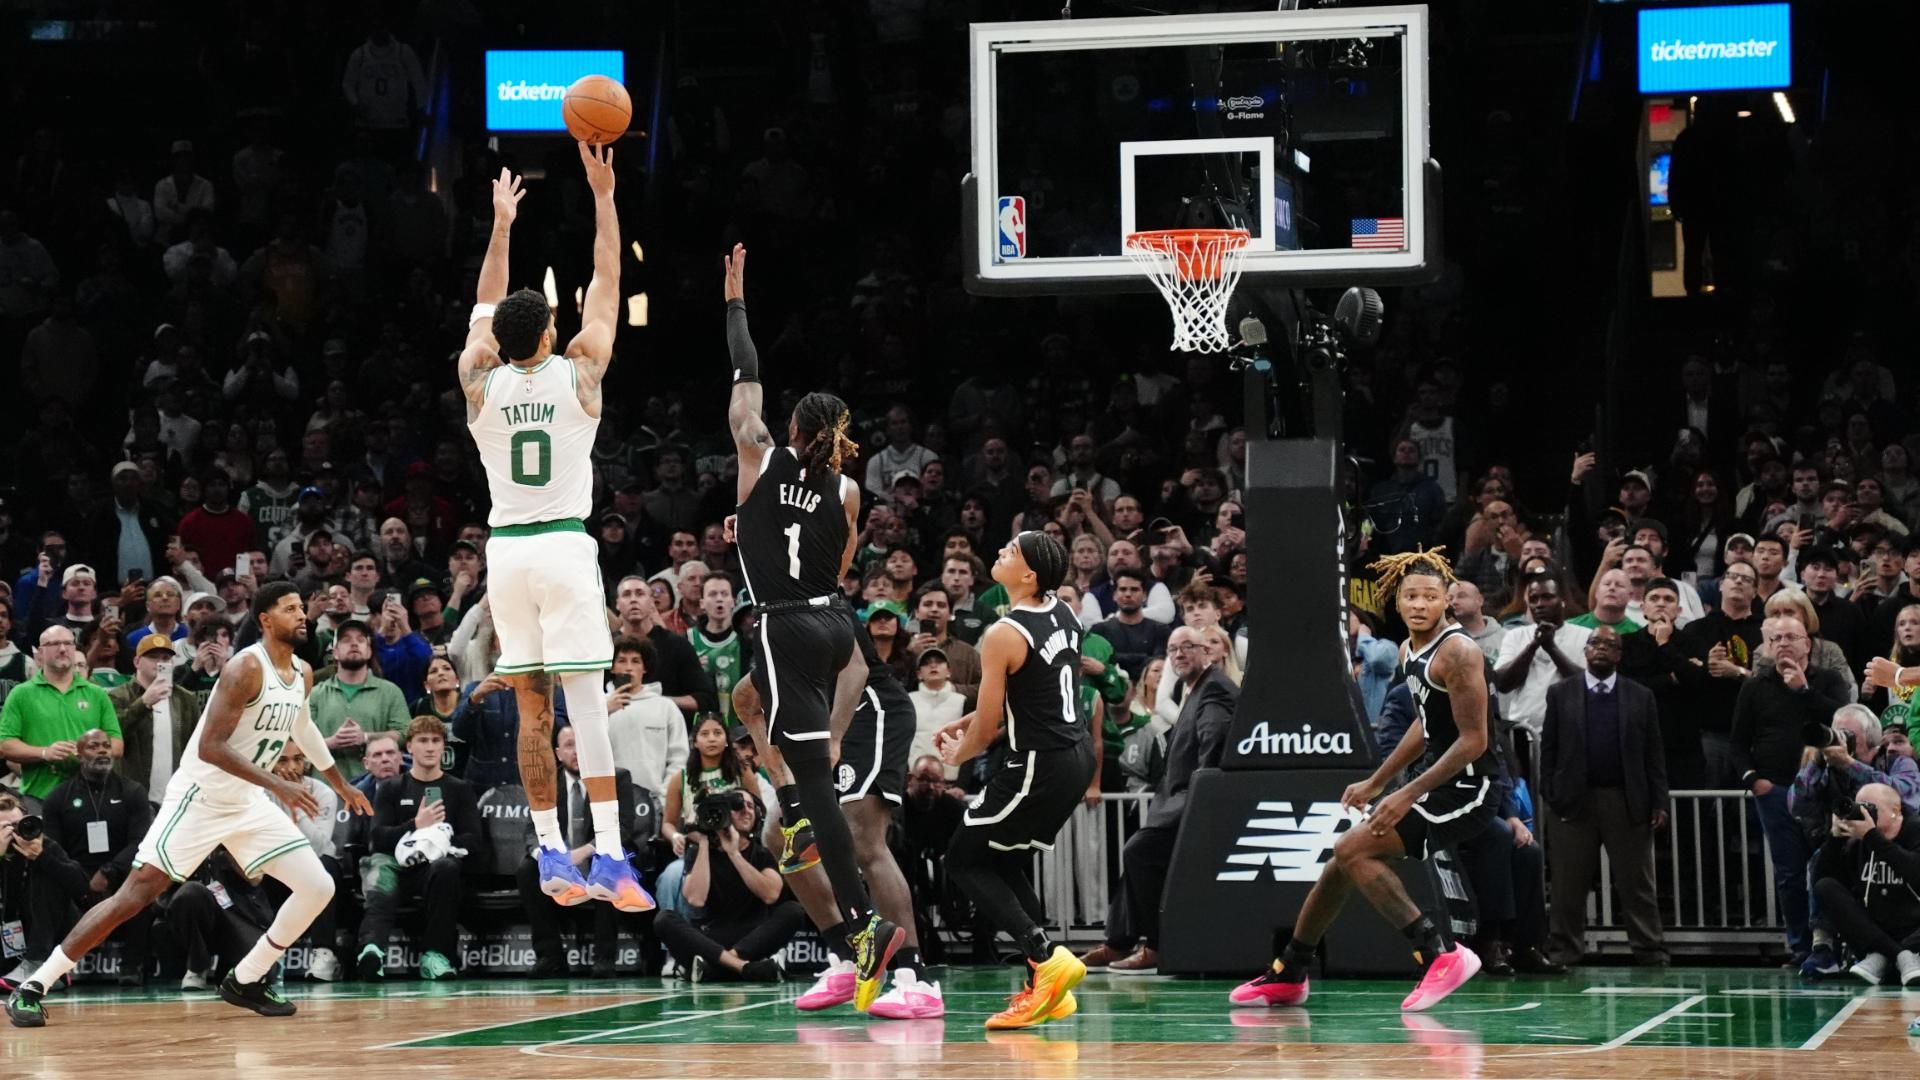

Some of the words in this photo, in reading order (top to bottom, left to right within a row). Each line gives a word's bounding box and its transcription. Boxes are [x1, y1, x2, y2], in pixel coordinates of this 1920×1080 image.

[1651, 39, 1778, 62] ticketmaster
[498, 80, 572, 101] ticketm
[1227, 112, 1264, 120] G-Flame
[1001, 244, 1016, 256] NBA
[501, 402, 555, 426] TATUM
[511, 429, 552, 487] 0
[779, 483, 822, 513] ELLIS
[784, 522, 802, 581] 1
[1059, 664, 1077, 724] 0
[254, 703, 301, 733] CELTIC
[1237, 721, 1353, 756] Amica
[459, 944, 537, 971] jetBlue
[786, 941, 830, 963] tBlu
